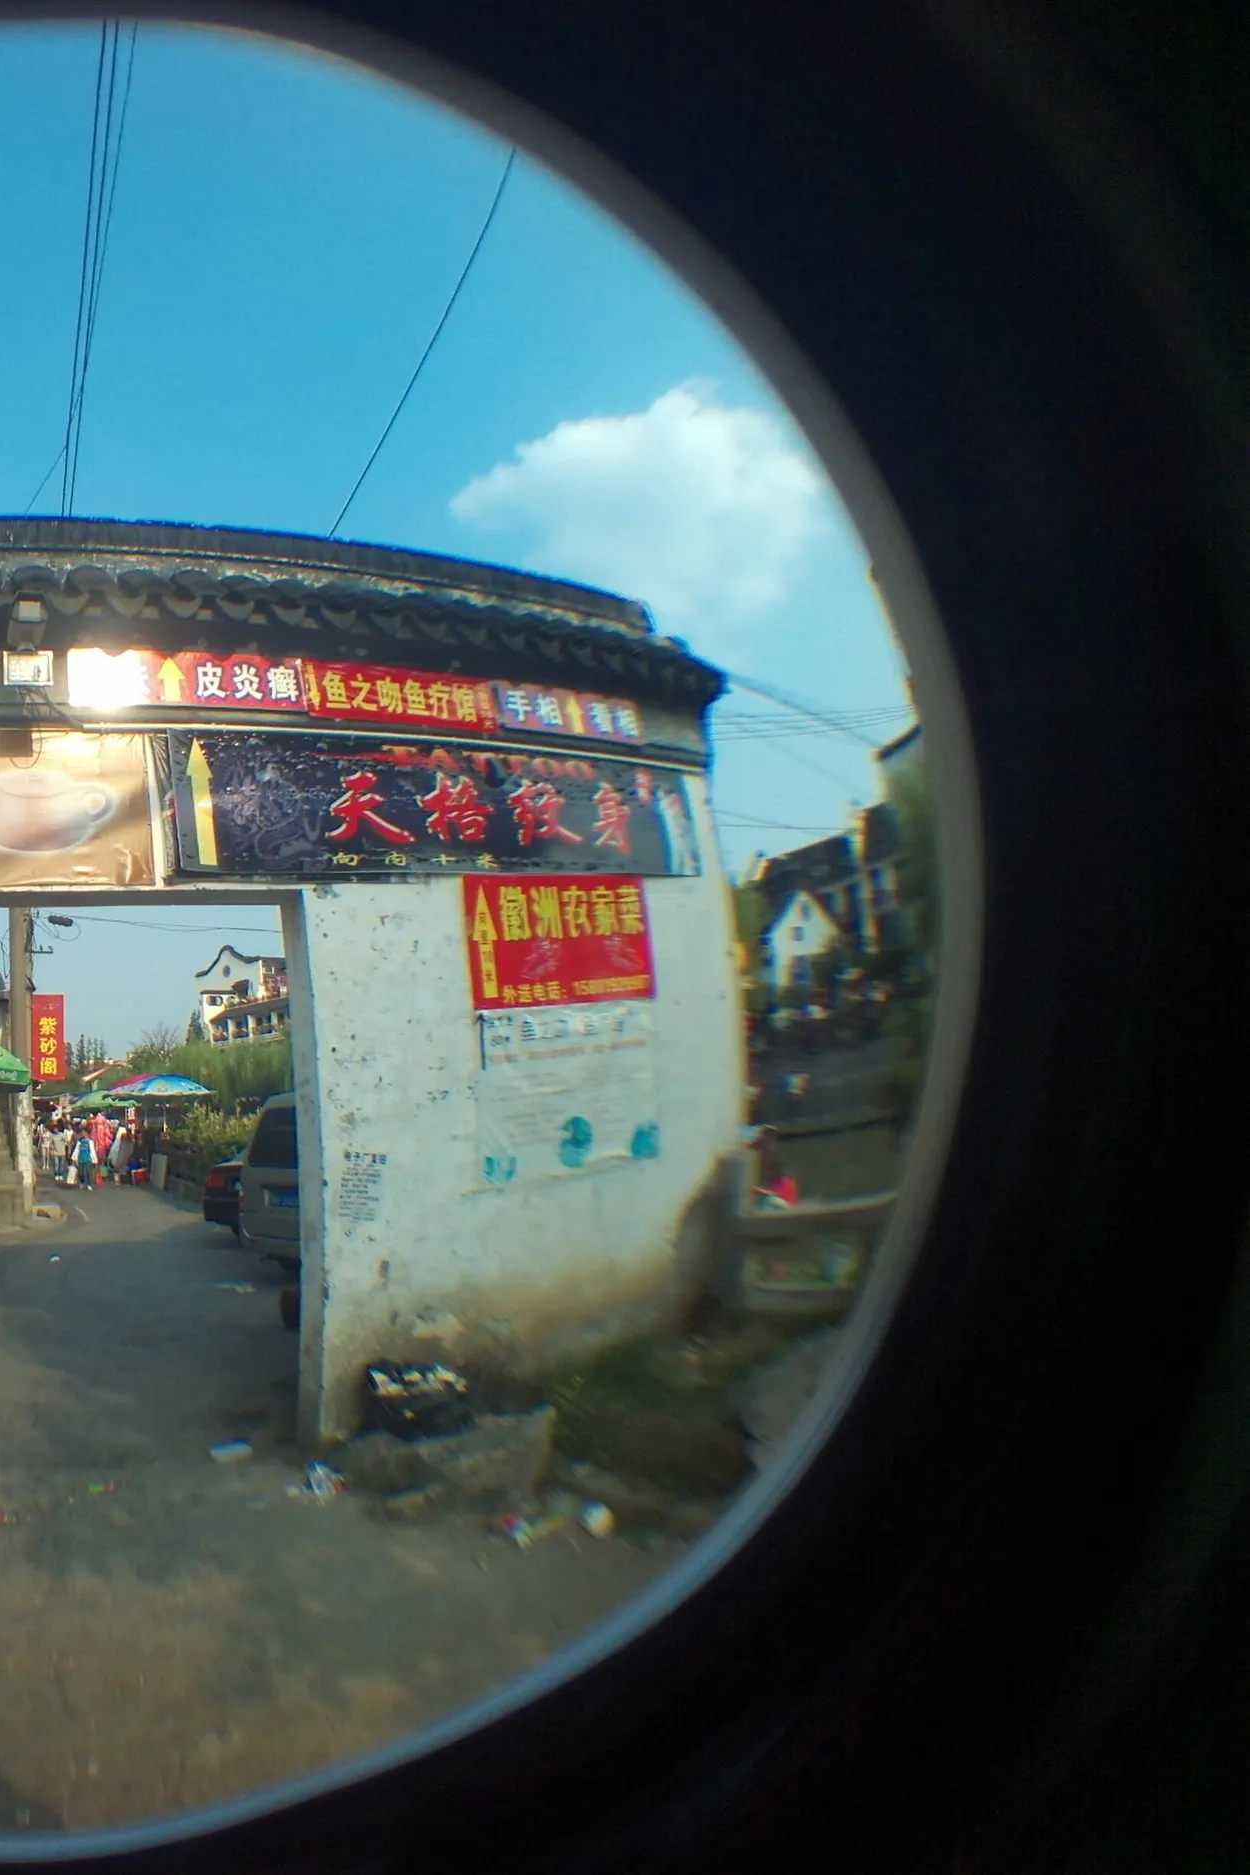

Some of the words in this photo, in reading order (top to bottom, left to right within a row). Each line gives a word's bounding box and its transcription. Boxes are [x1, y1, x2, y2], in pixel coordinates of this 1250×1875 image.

[196, 661, 299, 701] 皮炎癣
[322, 670, 478, 722] 鱼之吻鱼疗馆
[39, 1016, 58, 1075] 紫砂阁
